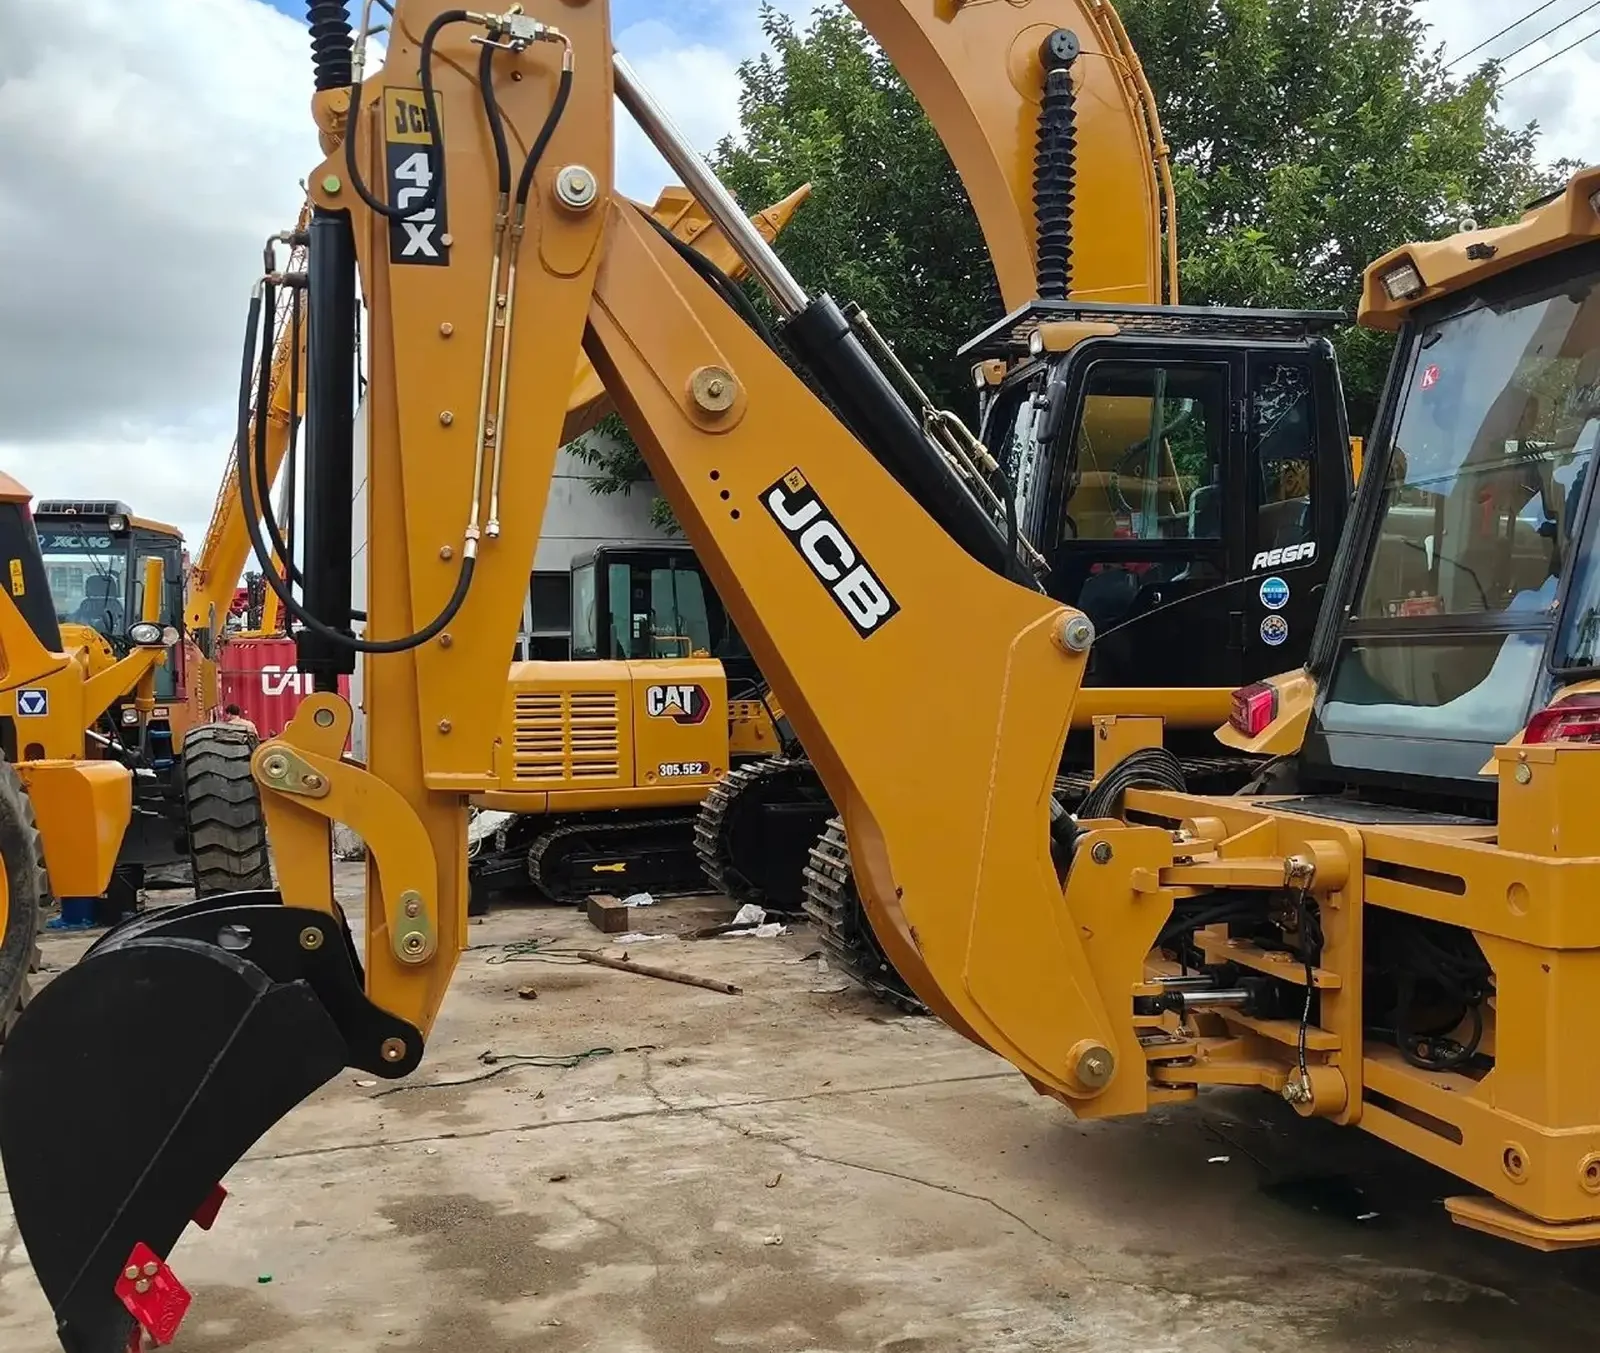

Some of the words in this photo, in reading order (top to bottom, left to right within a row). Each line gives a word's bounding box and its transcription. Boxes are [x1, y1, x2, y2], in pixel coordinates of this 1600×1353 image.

[768, 487, 891, 629] JCB
[647, 685, 695, 716] CAT
[659, 762, 703, 776] 305.5E2
